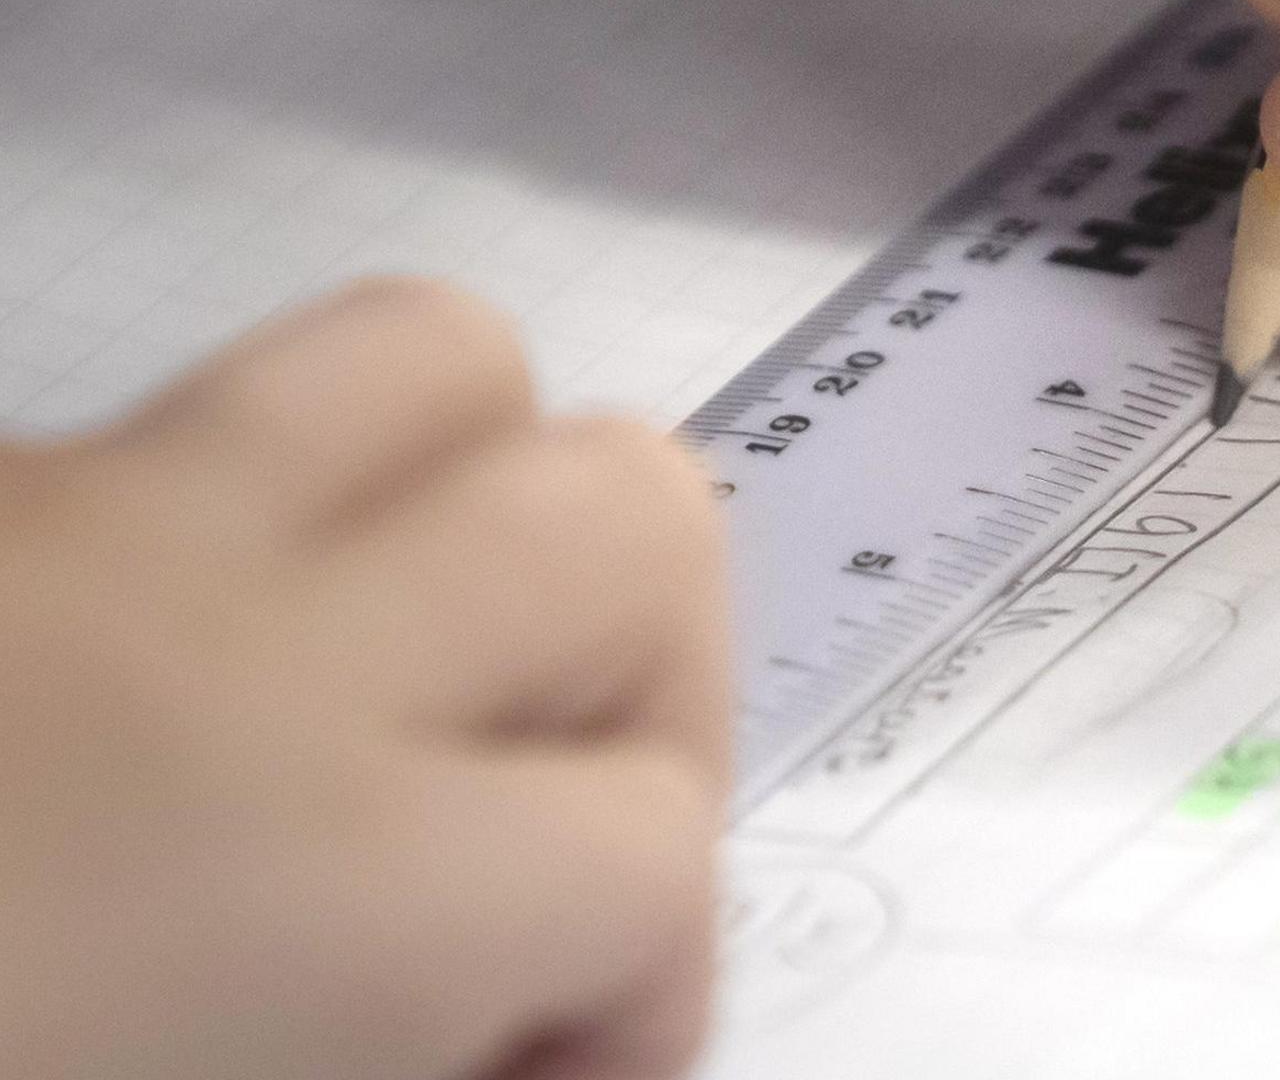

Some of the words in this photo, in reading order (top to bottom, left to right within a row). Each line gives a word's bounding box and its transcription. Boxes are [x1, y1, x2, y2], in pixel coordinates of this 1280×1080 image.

[744, 414, 811, 456] 19
[813, 350, 885, 397] 20
[888, 289, 963, 330] 21
[1043, 378, 1087, 398] 4
[851, 550, 896, 570] 5
